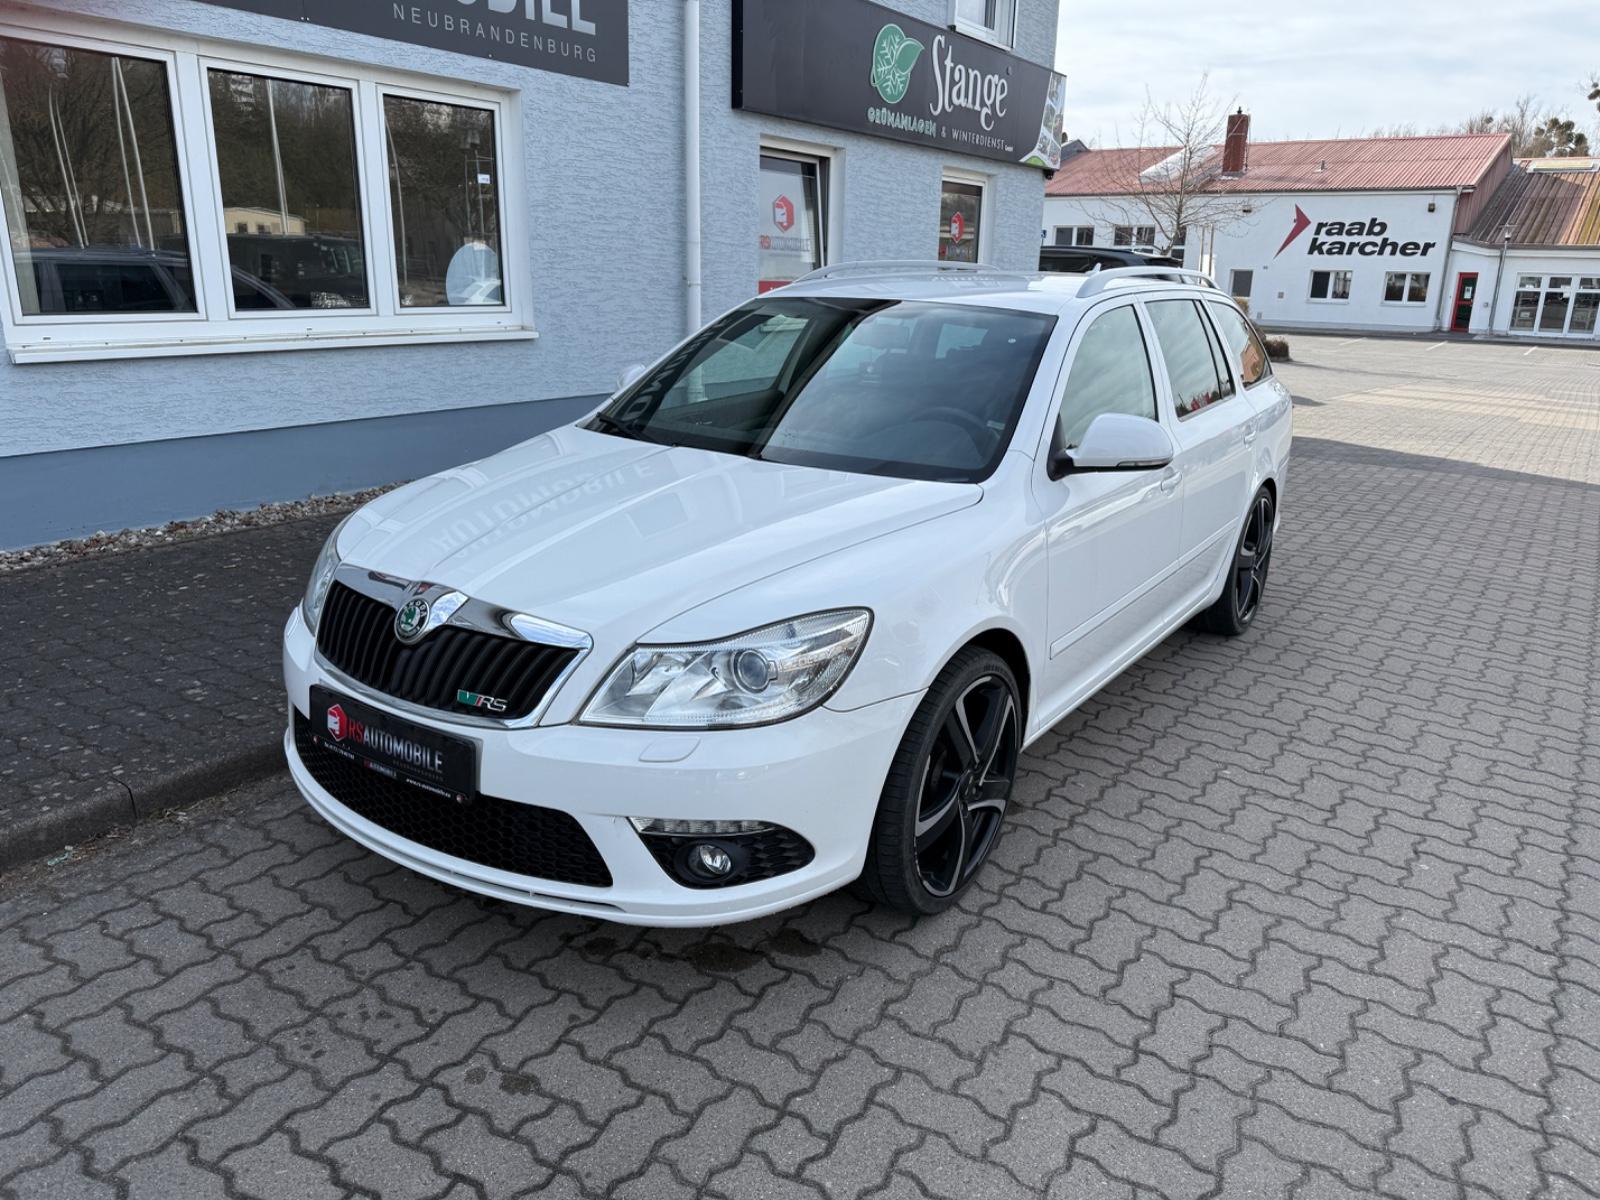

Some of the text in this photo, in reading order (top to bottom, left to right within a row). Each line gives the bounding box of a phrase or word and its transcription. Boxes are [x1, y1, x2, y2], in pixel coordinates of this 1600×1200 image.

[392, 2, 597, 63] NEUBRANDENBURG
[929, 34, 1008, 131] Stange
[867, 106, 937, 138] GRÜNANLAGEN
[951, 128, 1005, 150] WINTERDIENST
[1307, 237, 1437, 257] karcher
[1313, 217, 1388, 237] raab
